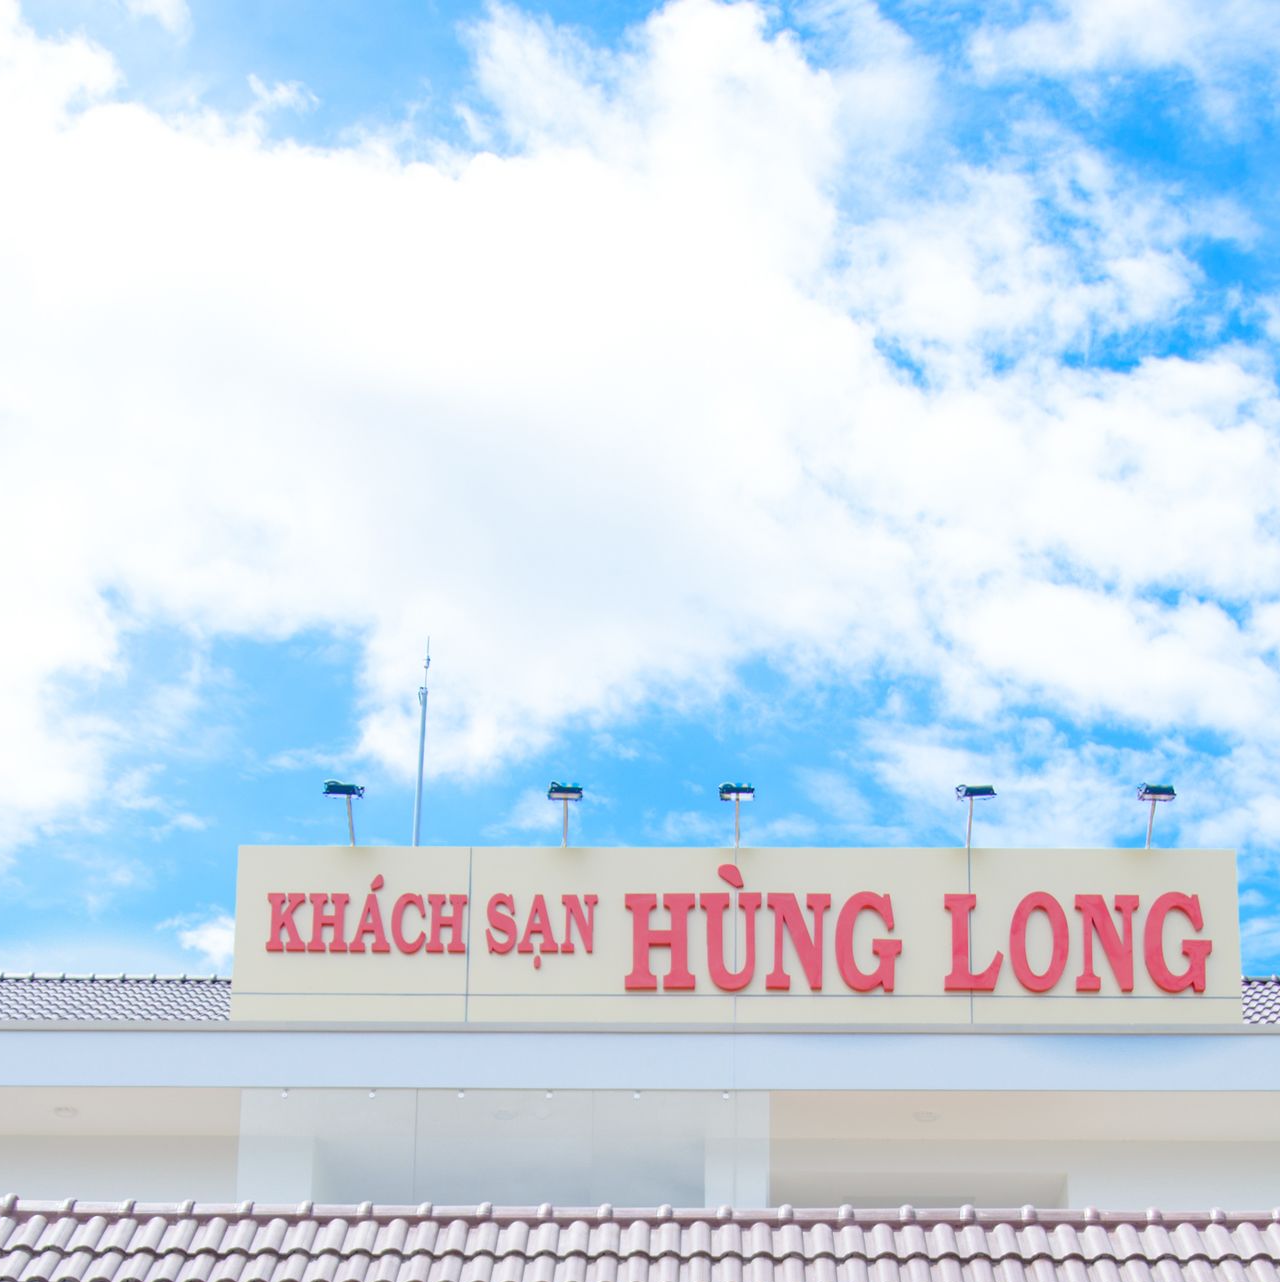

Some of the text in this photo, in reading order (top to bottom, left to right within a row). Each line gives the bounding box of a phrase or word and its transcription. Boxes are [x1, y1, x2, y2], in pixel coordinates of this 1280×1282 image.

[265, 863, 1213, 994] KHÁCH SẠN HÙNG LONG
